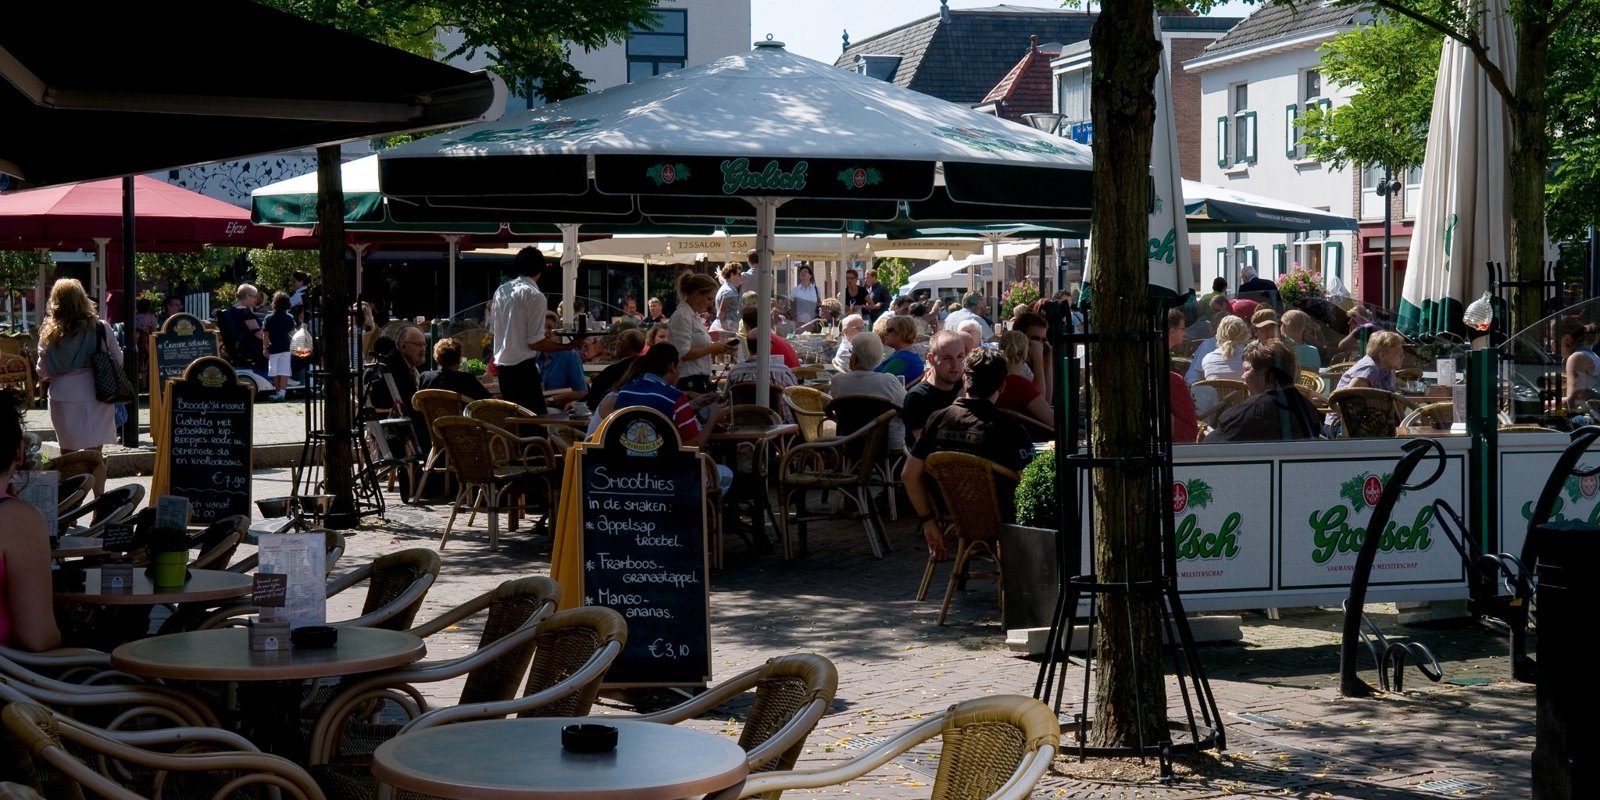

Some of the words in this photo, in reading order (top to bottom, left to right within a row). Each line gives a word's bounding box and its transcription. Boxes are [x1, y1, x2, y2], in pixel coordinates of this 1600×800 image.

[720, 157, 809, 194] Grolsch
[225, 221, 248, 237] Efeze
[729, 240, 748, 248] ISA
[175, 413, 213, 426] Ciabatta
[1309, 504, 1434, 564] Grosch
